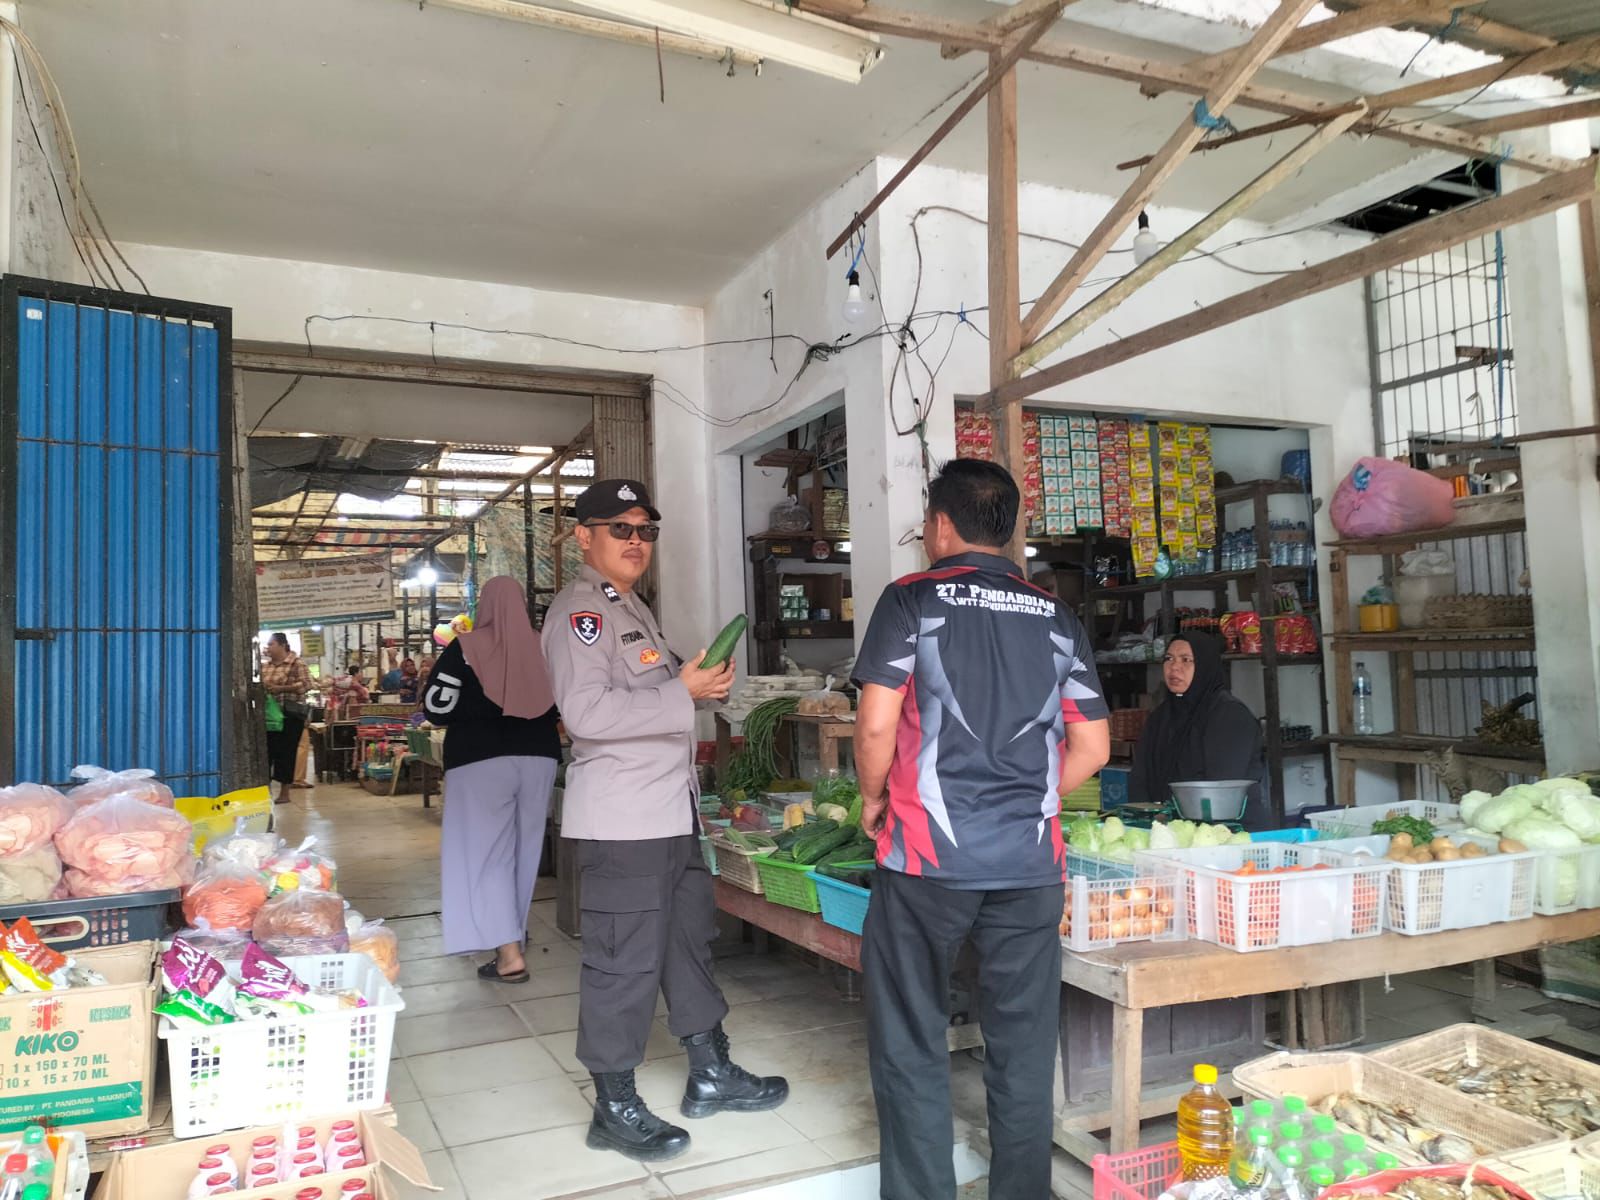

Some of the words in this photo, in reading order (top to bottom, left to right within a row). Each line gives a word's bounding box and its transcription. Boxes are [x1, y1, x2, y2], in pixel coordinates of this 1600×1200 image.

[15, 1031, 79, 1056] KIKO
[13, 1063, 19, 1074] 1
[36, 1060, 58, 1072] 150
[73, 1056, 88, 1067] 70
[92, 1054, 110, 1065] ML
[6, 1078, 19, 1089] 10
[43, 1074, 57, 1085] 15
[73, 1070, 88, 1081] 70
[92, 1068, 109, 1079] ML
